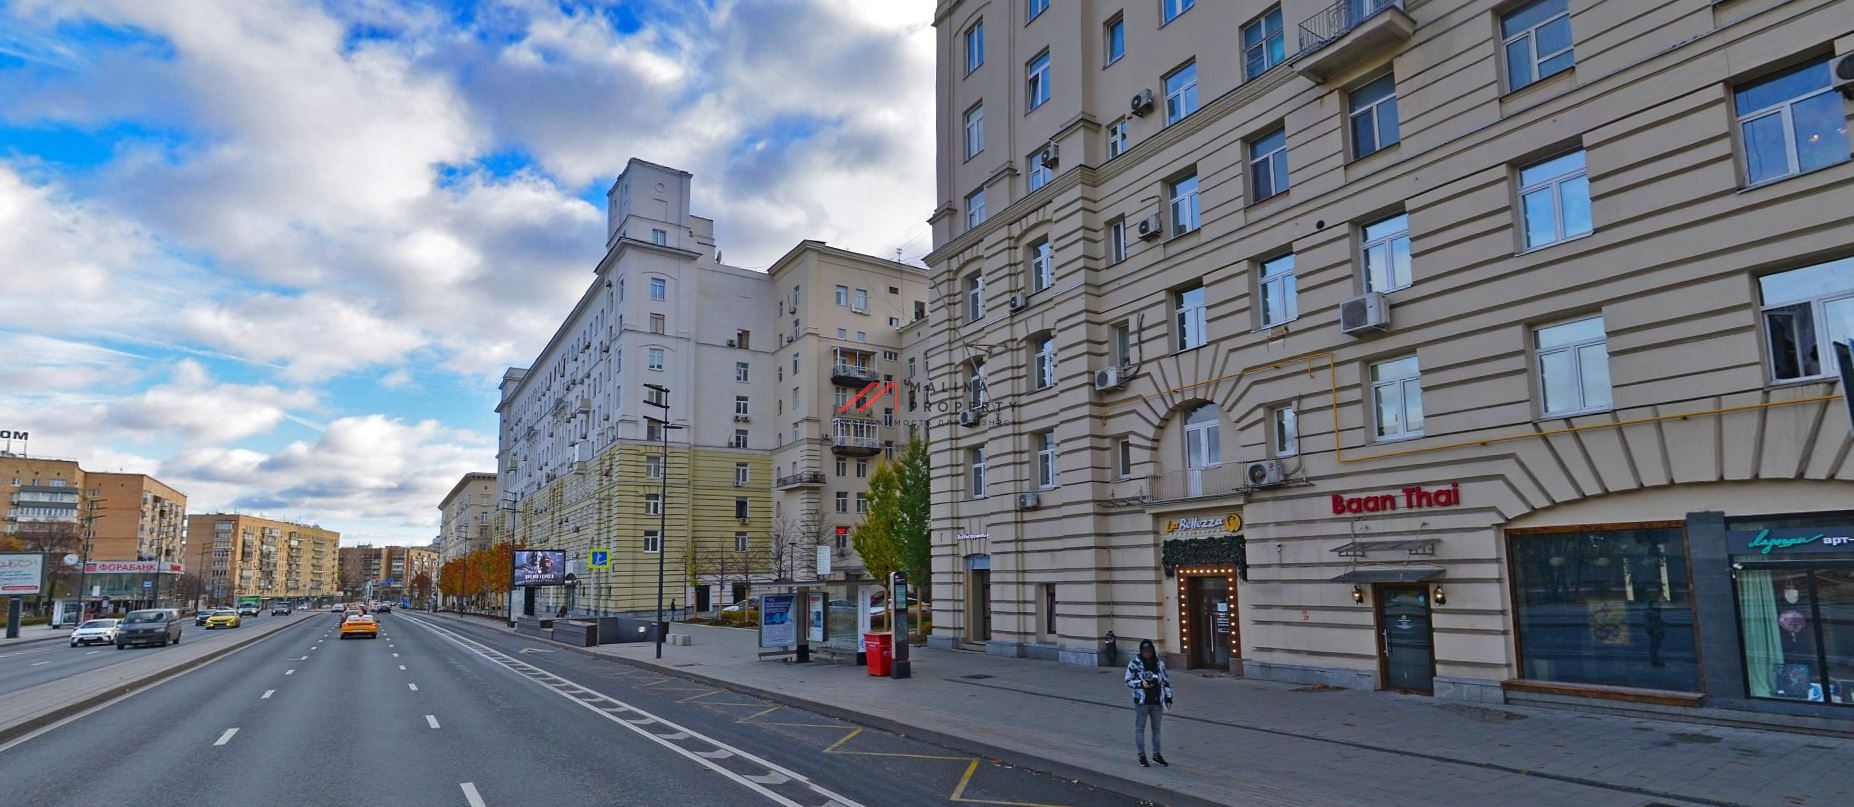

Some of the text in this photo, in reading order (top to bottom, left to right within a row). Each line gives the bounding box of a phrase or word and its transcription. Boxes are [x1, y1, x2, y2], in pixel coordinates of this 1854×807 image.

[1331, 482, 1461, 515] Baan Thai
[99, 563, 157, 571] ФОРАБАНК
